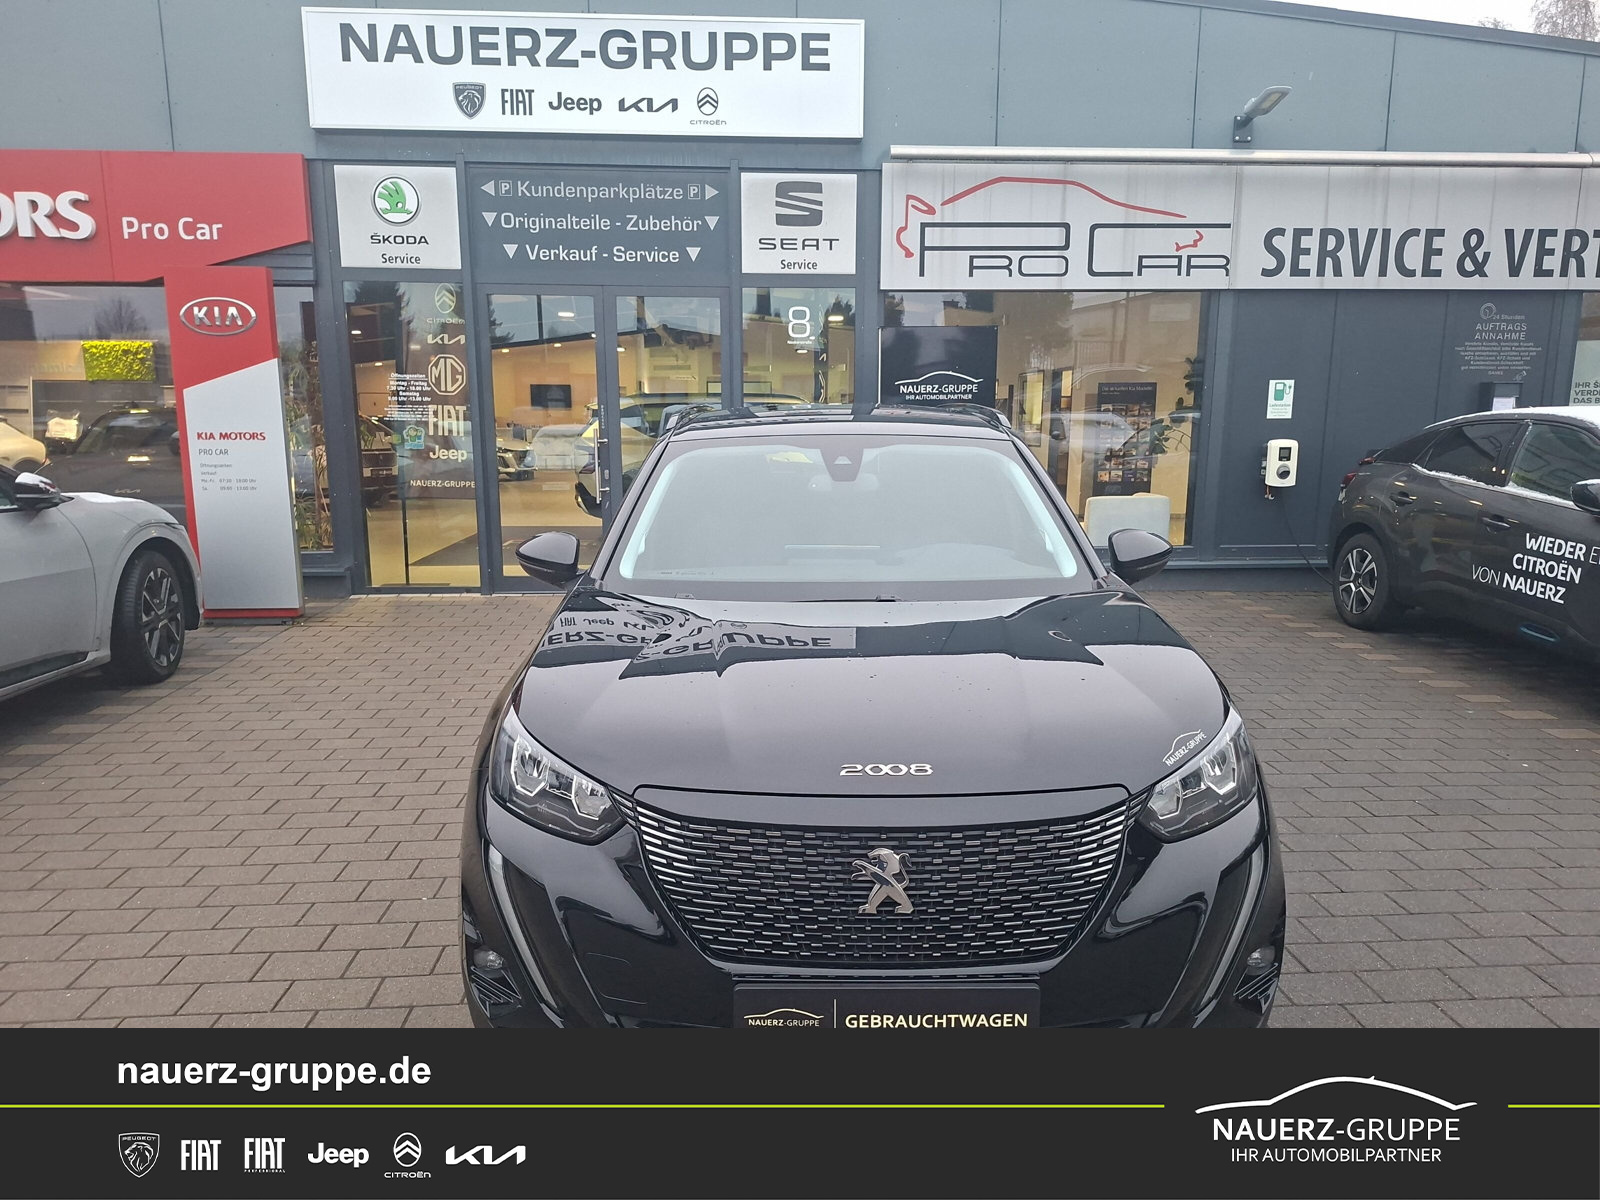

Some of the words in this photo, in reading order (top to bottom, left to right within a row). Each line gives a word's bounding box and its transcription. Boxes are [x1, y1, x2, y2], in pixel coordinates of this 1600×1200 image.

[339, 22, 830, 72] NAUERZ-GRUPPE
[501, 88, 535, 116] FIAT
[548, 91, 602, 115] Jeep
[618, 97, 678, 112] KIA
[518, 180, 683, 203] Kundenparkplätze
[121, 216, 168, 240] Pro
[178, 217, 223, 240] Car
[501, 212, 610, 233] Originalteile
[626, 214, 701, 232] Zubehör
[370, 232, 429, 245] ŠKODA
[758, 237, 839, 251] SEAT
[381, 253, 421, 265] Service
[525, 244, 597, 261] Verkauf
[613, 246, 679, 263] Service
[1261, 227, 1446, 279] SERVICE
[1456, 227, 1491, 278] &
[780, 259, 818, 270] Service
[192, 305, 243, 326] KIA
[788, 306, 810, 337] 8
[1474, 332, 1526, 340] ANNAHME
[1475, 322, 1527, 331] AUFTRAGS
[427, 333, 466, 344] KIA
[431, 358, 463, 392] MG
[899, 384, 978, 394] NAUERZ-GRUPPE
[428, 404, 466, 436] FIAT
[196, 431, 216, 441] KIA
[219, 431, 266, 441] MOTORS
[198, 448, 213, 456] PRO
[214, 448, 229, 456] CAR
[429, 445, 467, 462] Jeep
[410, 480, 475, 488] NAUERZ-GRUPPE
[1525, 532, 1587, 561] WIEDER
[1512, 553, 1582, 585] CITROËN
[1472, 564, 1501, 586] VON
[1502, 573, 1567, 604] NAUERZ
[1164, 731, 1207, 767] NAUERZ-GRUPPE
[840, 763, 934, 776] 2008
[748, 1018, 820, 1027] NAUERZ-GRUPPE
[844, 1013, 1028, 1028] GEBRAUCHTWAGEN
